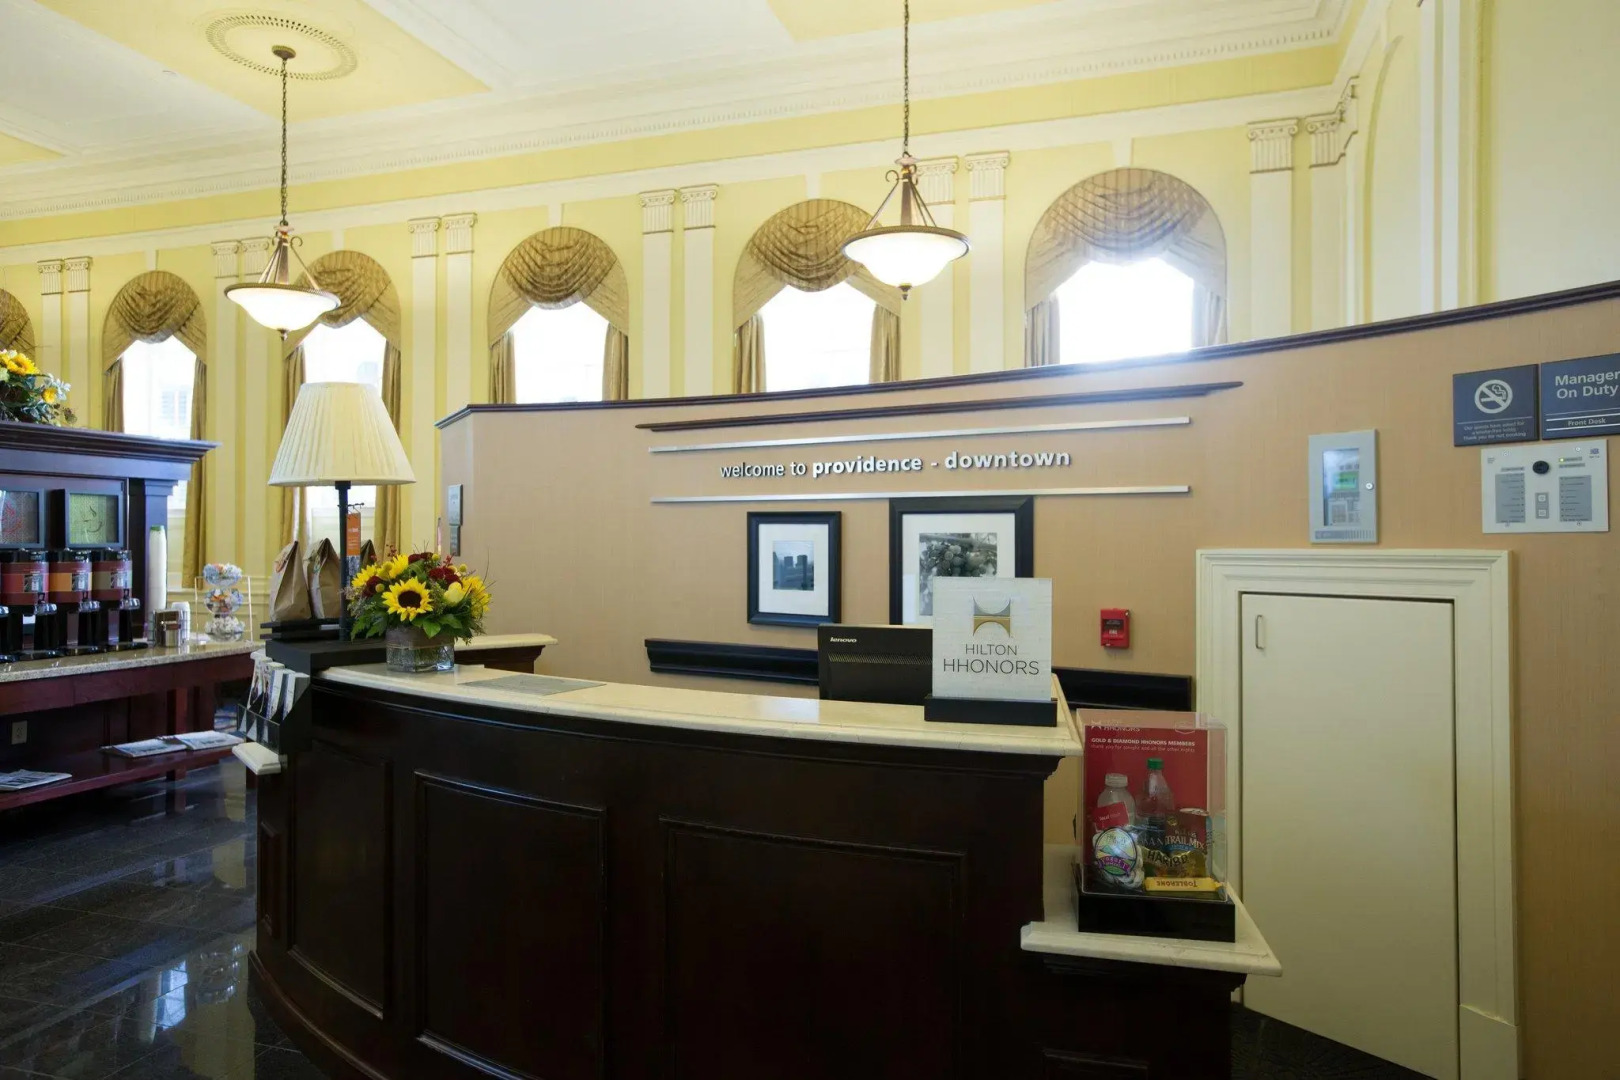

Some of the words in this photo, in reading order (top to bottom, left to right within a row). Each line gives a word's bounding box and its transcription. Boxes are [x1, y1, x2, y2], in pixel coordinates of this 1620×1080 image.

[1555, 371, 1620, 386] Manager
[1556, 388, 1577, 399] On
[1583, 384, 1619, 397] Duty
[720, 462, 785, 477] welcome
[790, 462, 807, 476] to
[812, 455, 923, 478] providence
[944, 451, 1071, 469] downtown
[829, 636, 857, 644] lenovo
[965, 643, 1018, 656] HILTON
[943, 658, 1040, 676] HHONORS
